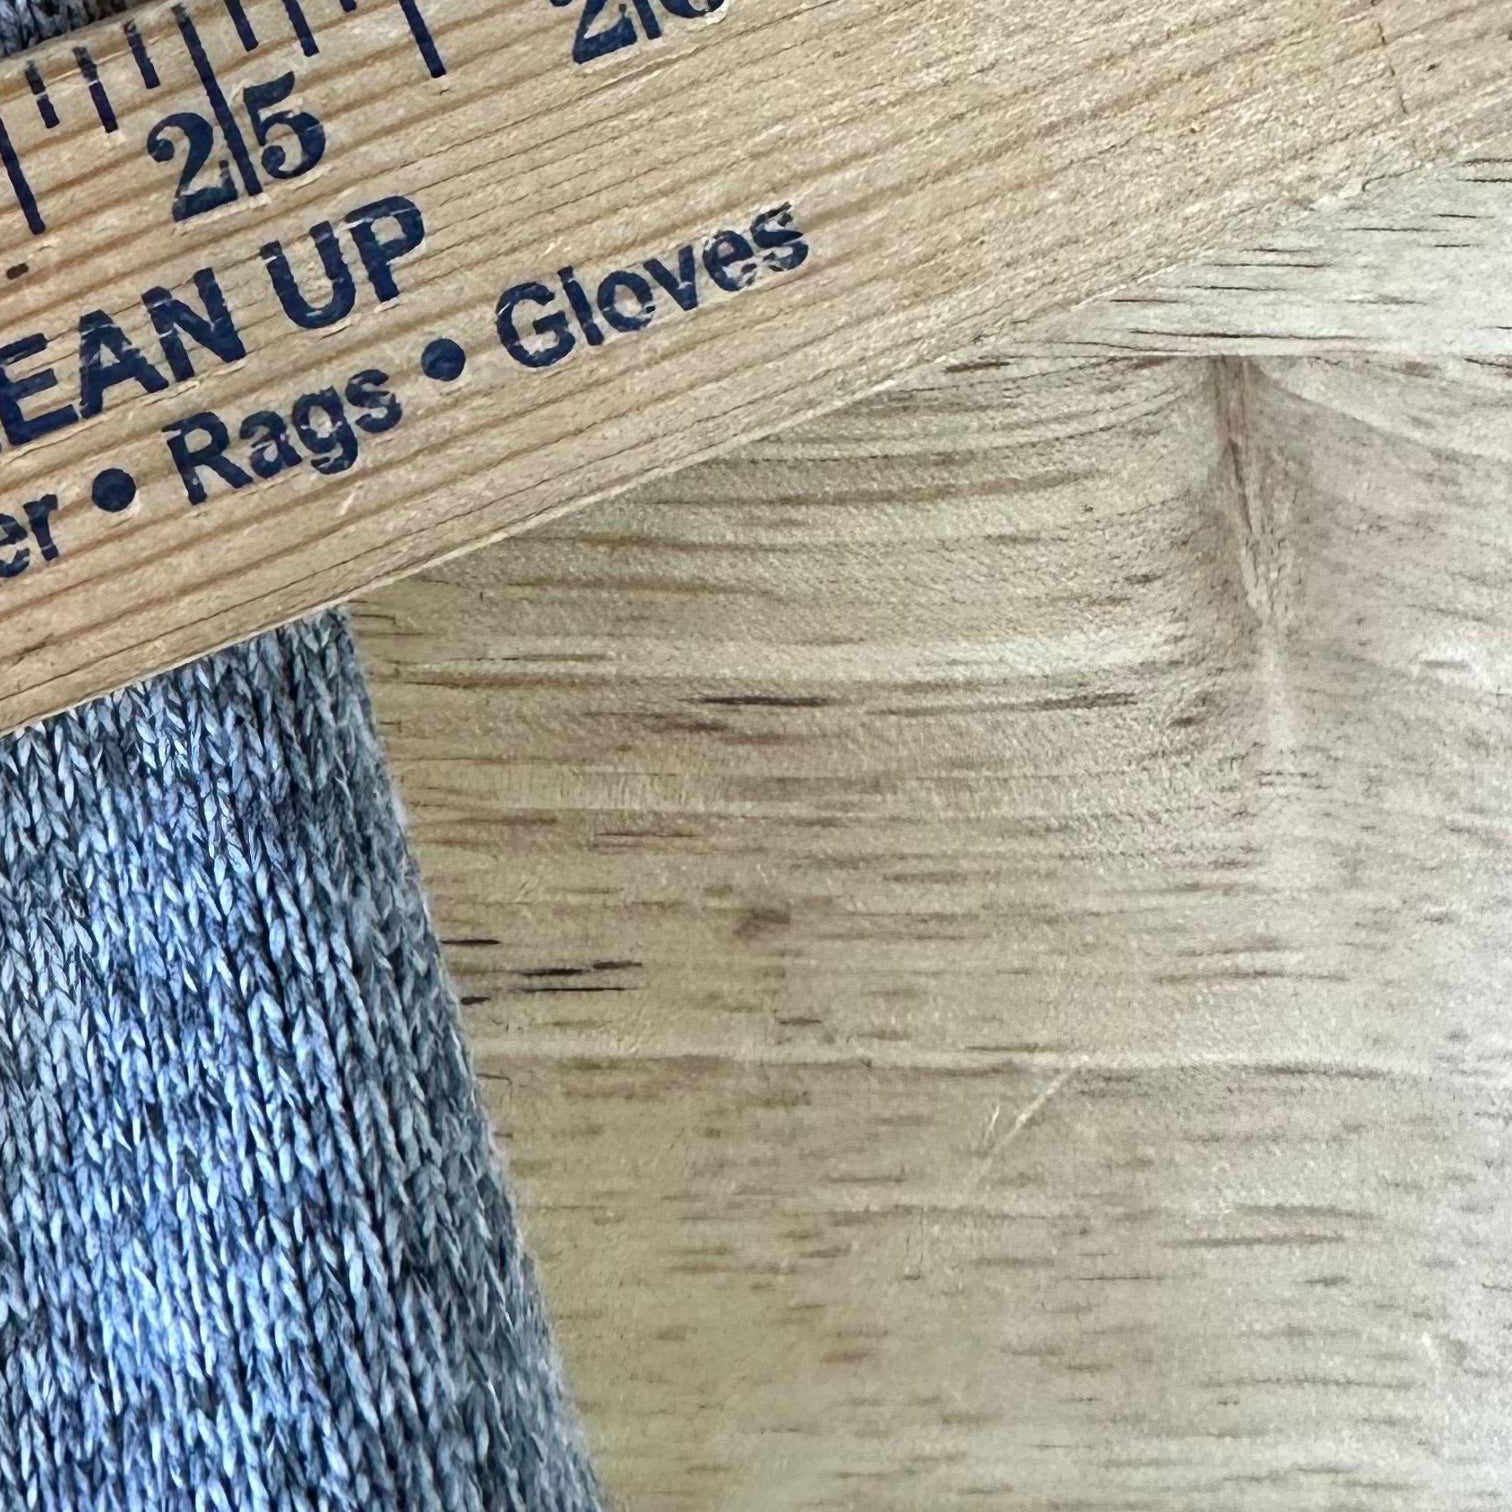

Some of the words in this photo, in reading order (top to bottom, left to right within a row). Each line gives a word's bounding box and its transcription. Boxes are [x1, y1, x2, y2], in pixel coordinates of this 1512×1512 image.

[146, 71, 328, 223] 25
[258, 194, 428, 330] UP
[164, 366, 404, 506] Rags
[495, 199, 810, 369] Gloves
